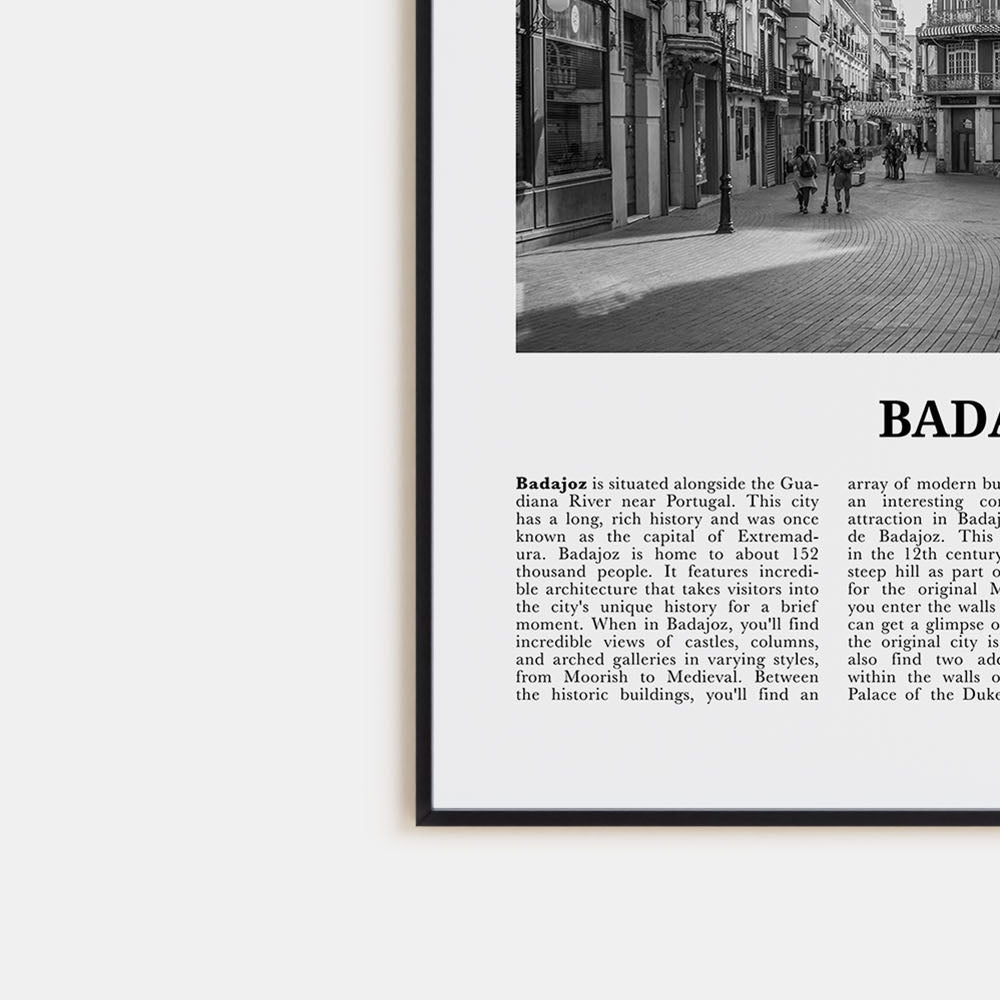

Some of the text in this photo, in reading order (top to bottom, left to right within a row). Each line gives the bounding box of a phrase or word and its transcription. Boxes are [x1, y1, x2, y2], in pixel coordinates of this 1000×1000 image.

[516, 477, 819, 495] Badajoz is situated alongside the Gua-
[848, 481, 888, 495] array
[894, 477, 911, 491] of
[917, 477, 976, 491] modern
[516, 512, 819, 530] has a long, rich history and was once
[848, 513, 922, 526] attraction
[933, 513, 947, 526] in
[516, 547, 819, 565] ura. Badajoz is home to about 152
[848, 548, 862, 561] in
[871, 547, 894, 561] the
[906, 547, 937, 561] 12th
[516, 565, 819, 583] thousand people. It features incredi-
[848, 567, 886, 583] steep
[896, 565, 919, 579] hill
[928, 569, 944, 579] as
[952, 567, 983, 583] part
[516, 600, 819, 618] the city's unique history for a brief
[848, 604, 875, 618] you
[881, 602, 921, 614] enter
[928, 600, 951, 614] the
[958, 600, 996, 614] walls
[516, 617, 819, 635] moment. When in Badajoz, you'll find
[516, 652, 819, 670] and arched galleries in varying styles,
[848, 652, 877, 666] also
[892, 652, 922, 666] find
[936, 654, 963, 666] two
[516, 687, 818, 705] the historic buildings, you'll find an
[848, 687, 897, 701] Palace
[905, 687, 922, 701] of
[931, 687, 954, 701] the
